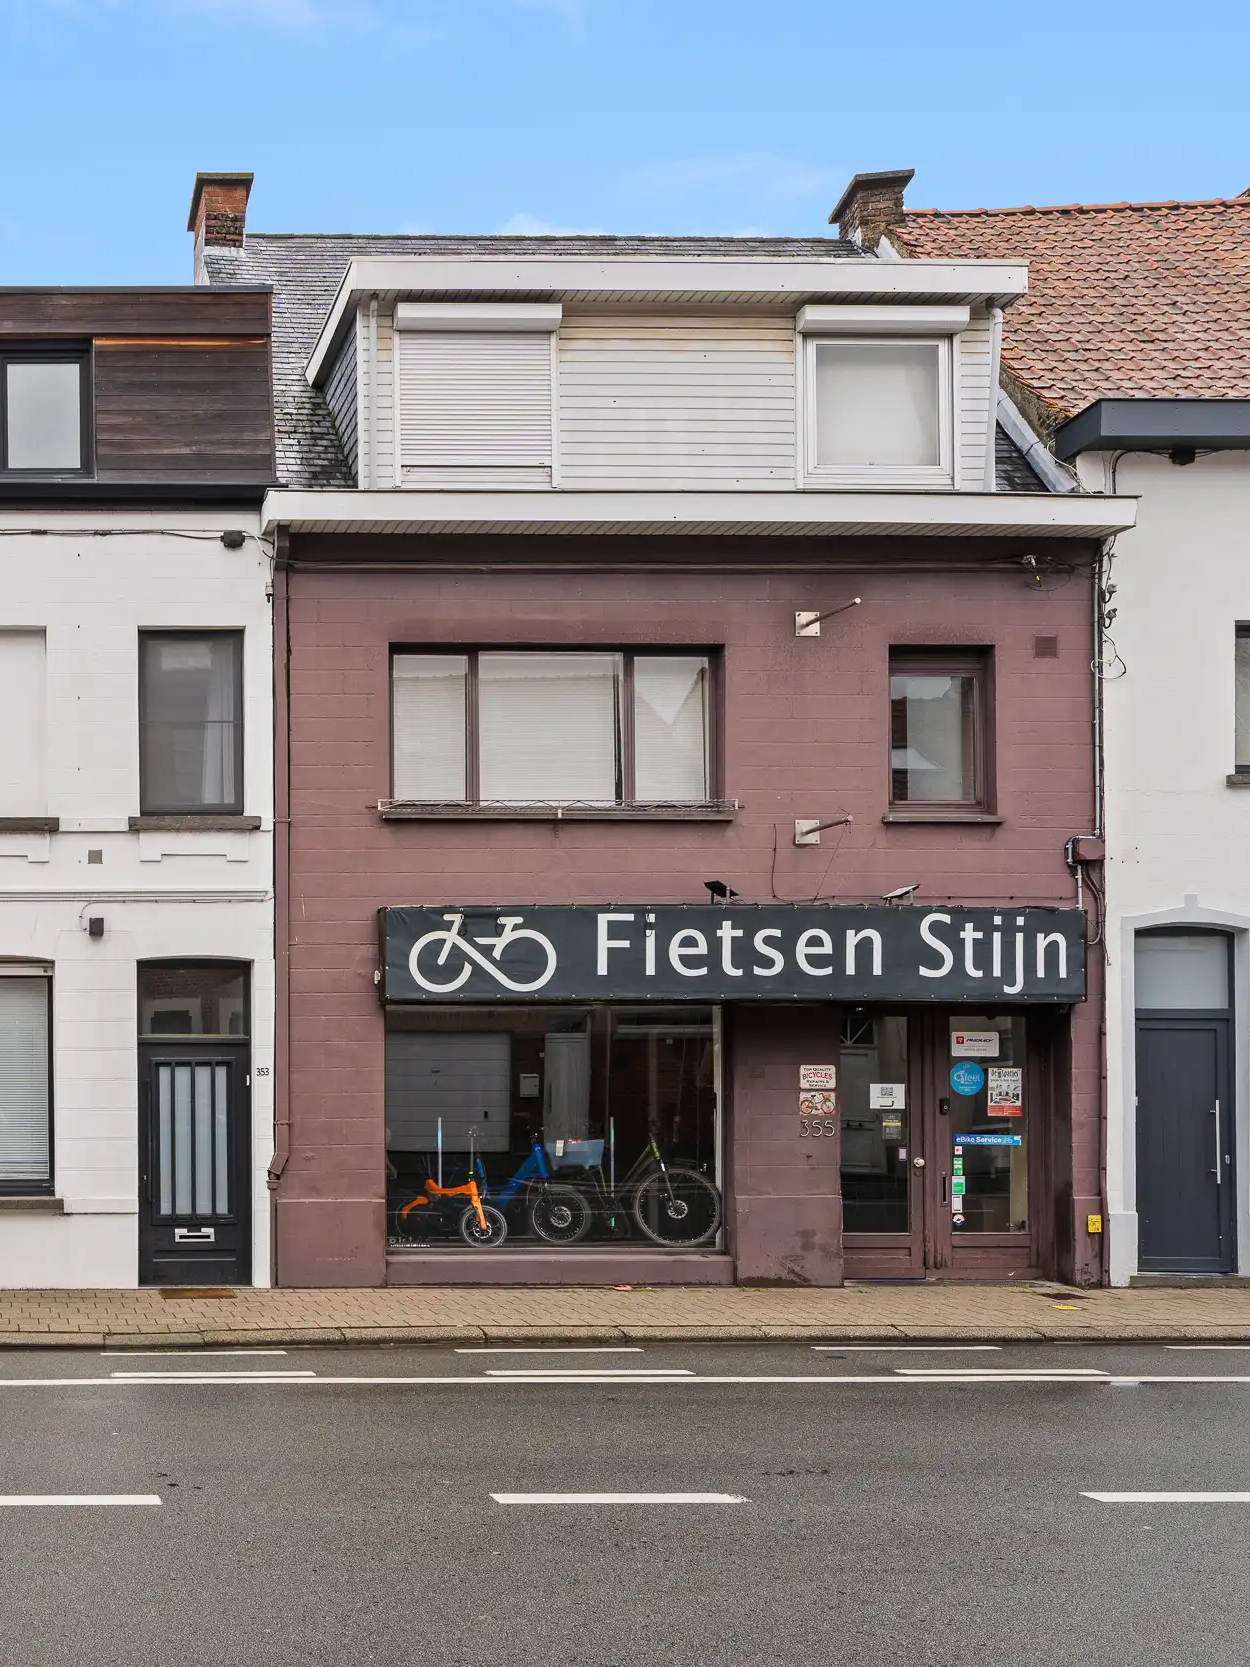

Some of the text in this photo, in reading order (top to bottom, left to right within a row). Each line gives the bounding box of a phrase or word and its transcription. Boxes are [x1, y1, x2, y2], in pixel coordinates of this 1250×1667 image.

[596, 912, 1068, 995] Fietsen Stijn
[256, 1067, 270, 1077] 353
[802, 1071, 833, 1081] BICYCLES
[799, 1119, 835, 1137] 355
[956, 1135, 975, 1143] eBike
